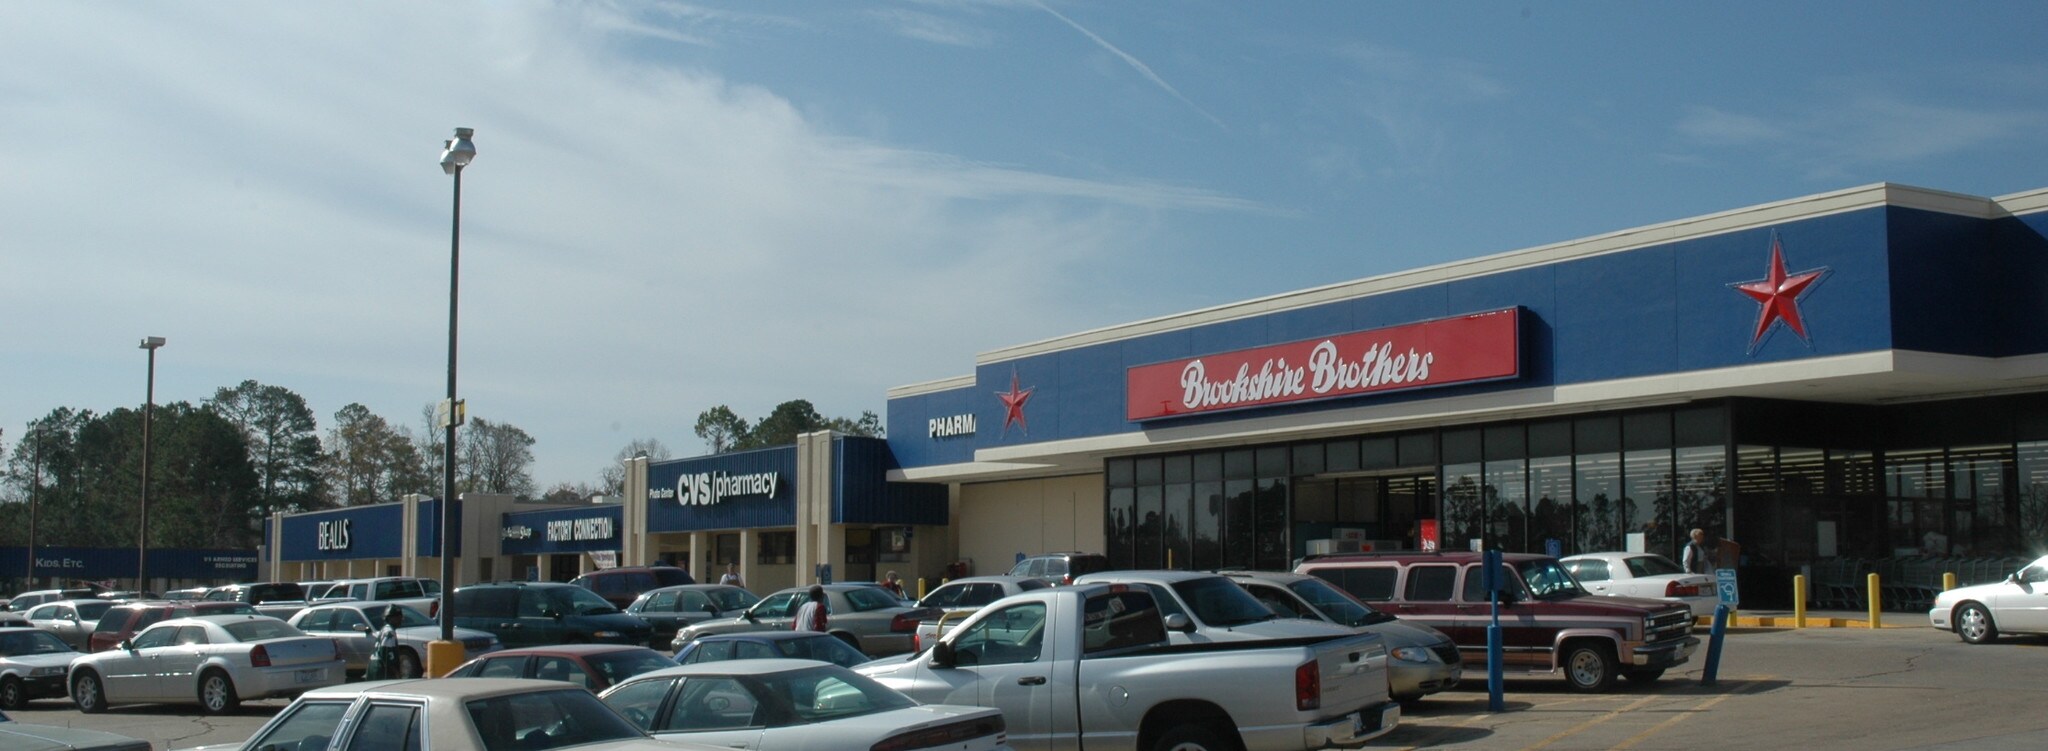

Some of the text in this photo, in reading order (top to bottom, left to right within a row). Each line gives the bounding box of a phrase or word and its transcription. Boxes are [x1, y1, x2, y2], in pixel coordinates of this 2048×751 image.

[1181, 340, 1433, 409] Brookshire Brothers
[677, 470, 778, 506] CVS/pharmacy
[318, 518, 349, 550] BEALLS
[547, 520, 573, 542] FACTORY
[573, 517, 613, 541] CONNECTION
